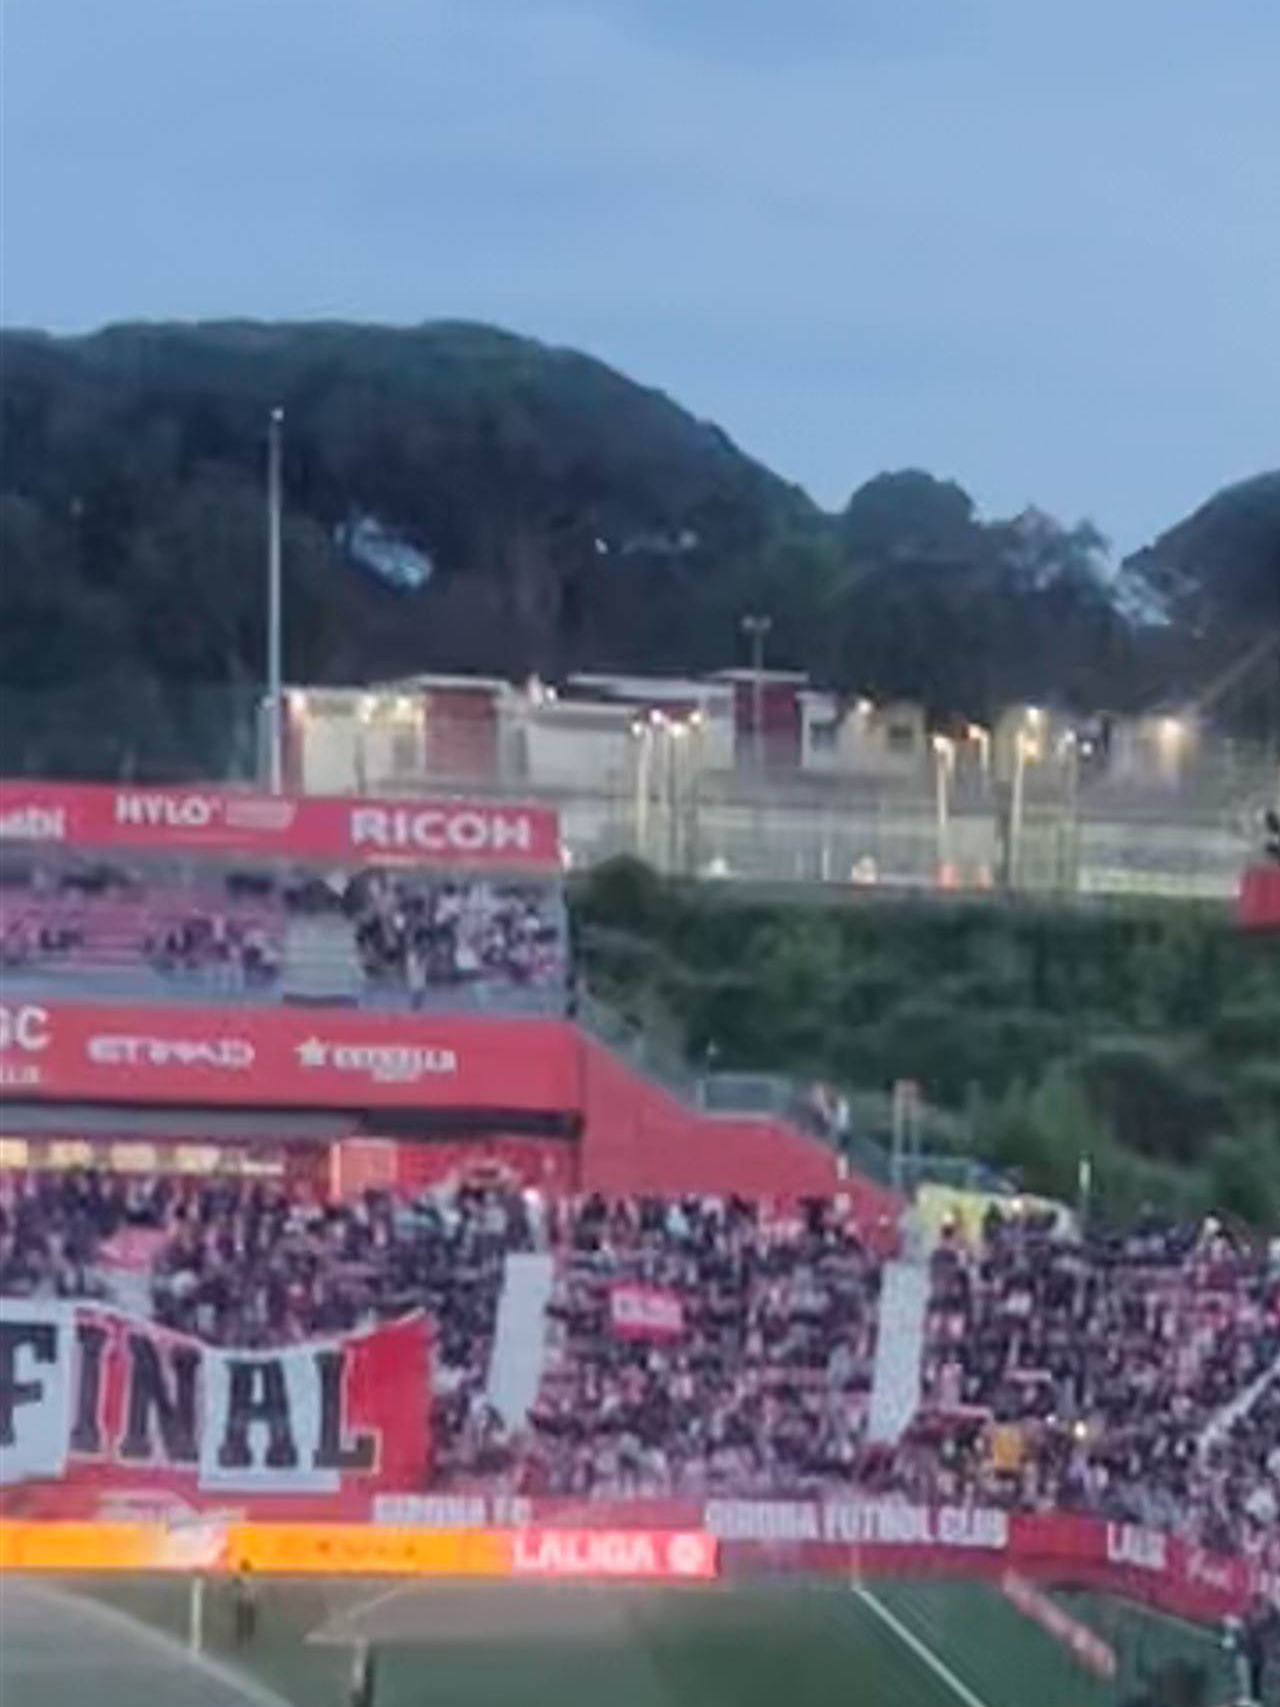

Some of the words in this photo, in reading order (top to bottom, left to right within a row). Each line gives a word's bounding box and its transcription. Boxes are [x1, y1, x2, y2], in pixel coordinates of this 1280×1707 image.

[350, 808, 532, 849] RICOH
[0, 1323, 376, 1469] FINAL
[513, 1529, 654, 1569] LALIGA
